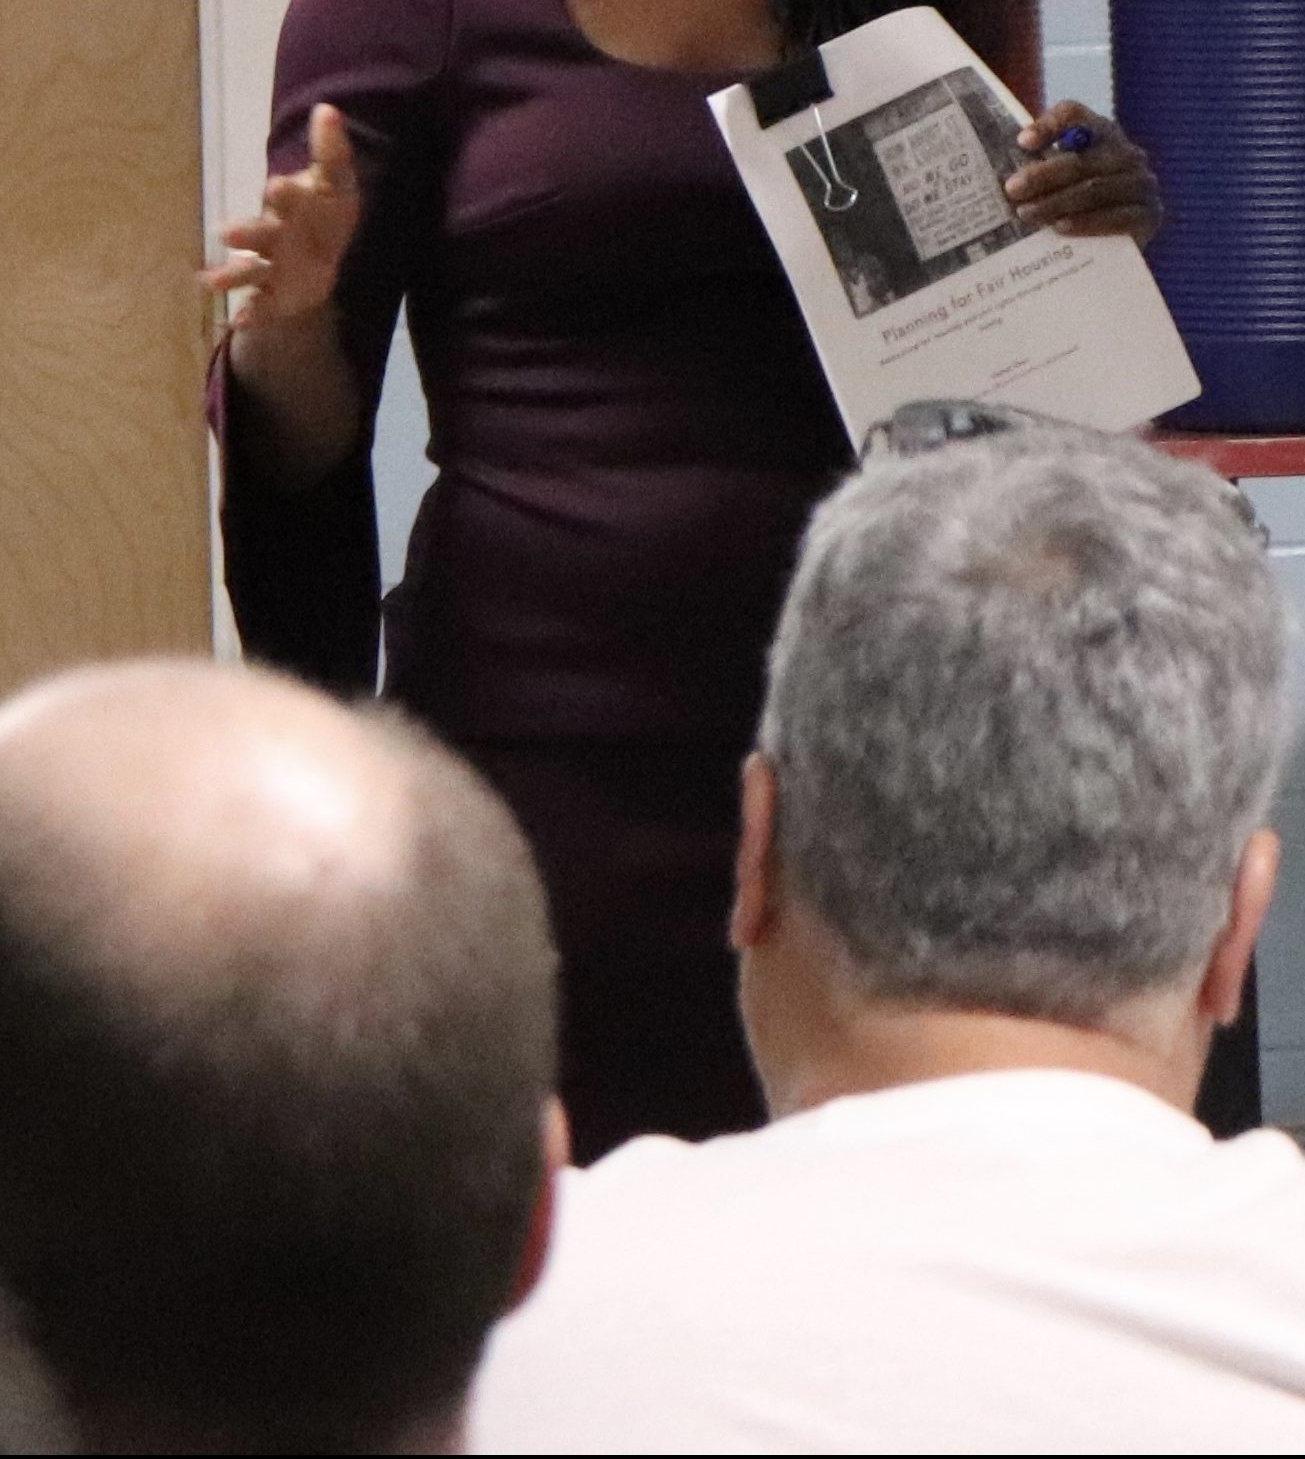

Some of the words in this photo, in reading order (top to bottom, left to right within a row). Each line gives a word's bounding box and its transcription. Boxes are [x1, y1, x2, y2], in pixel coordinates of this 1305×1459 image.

[881, 305, 949, 343] Planning
[950, 293, 972, 310] for
[976, 278, 1005, 297] Fair
[1008, 244, 1074, 280] Housing
